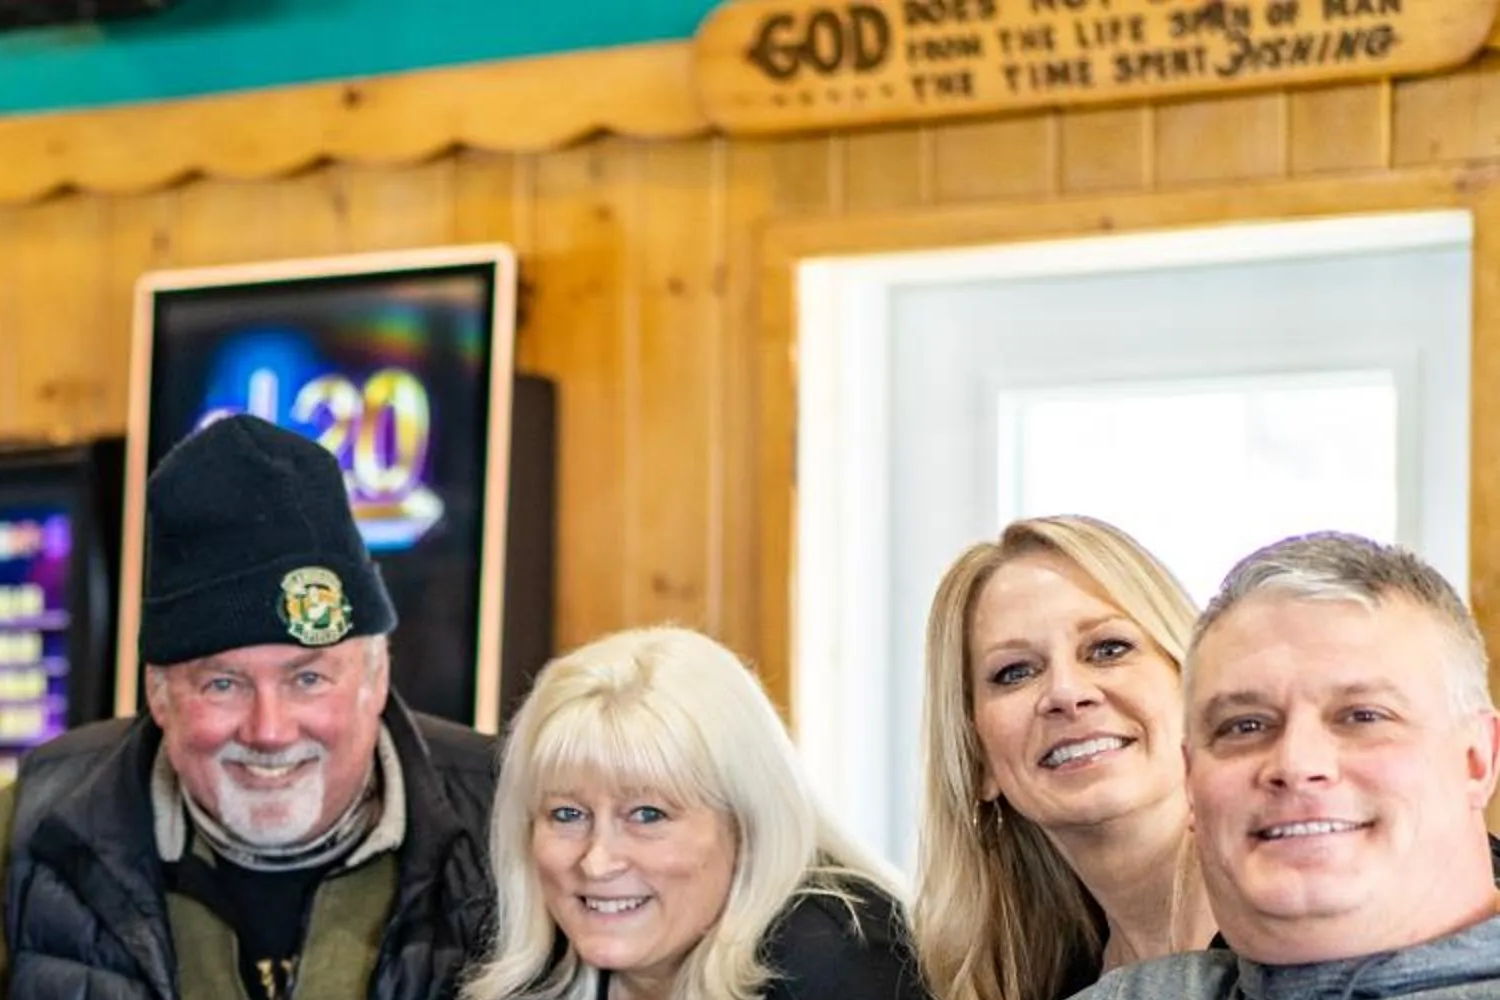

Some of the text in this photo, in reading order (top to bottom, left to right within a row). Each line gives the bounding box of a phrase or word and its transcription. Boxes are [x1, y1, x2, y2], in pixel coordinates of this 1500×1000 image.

[745, 3, 892, 81] GOD
[906, 36, 983, 61] FROM
[999, 24, 1056, 53] THE
[1073, 14, 1146, 48] LIFE
[1265, 1, 1298, 28] OF
[1322, 0, 1401, 21] MAN
[910, 26, 1399, 102] THE TIME SPENT FISHING
